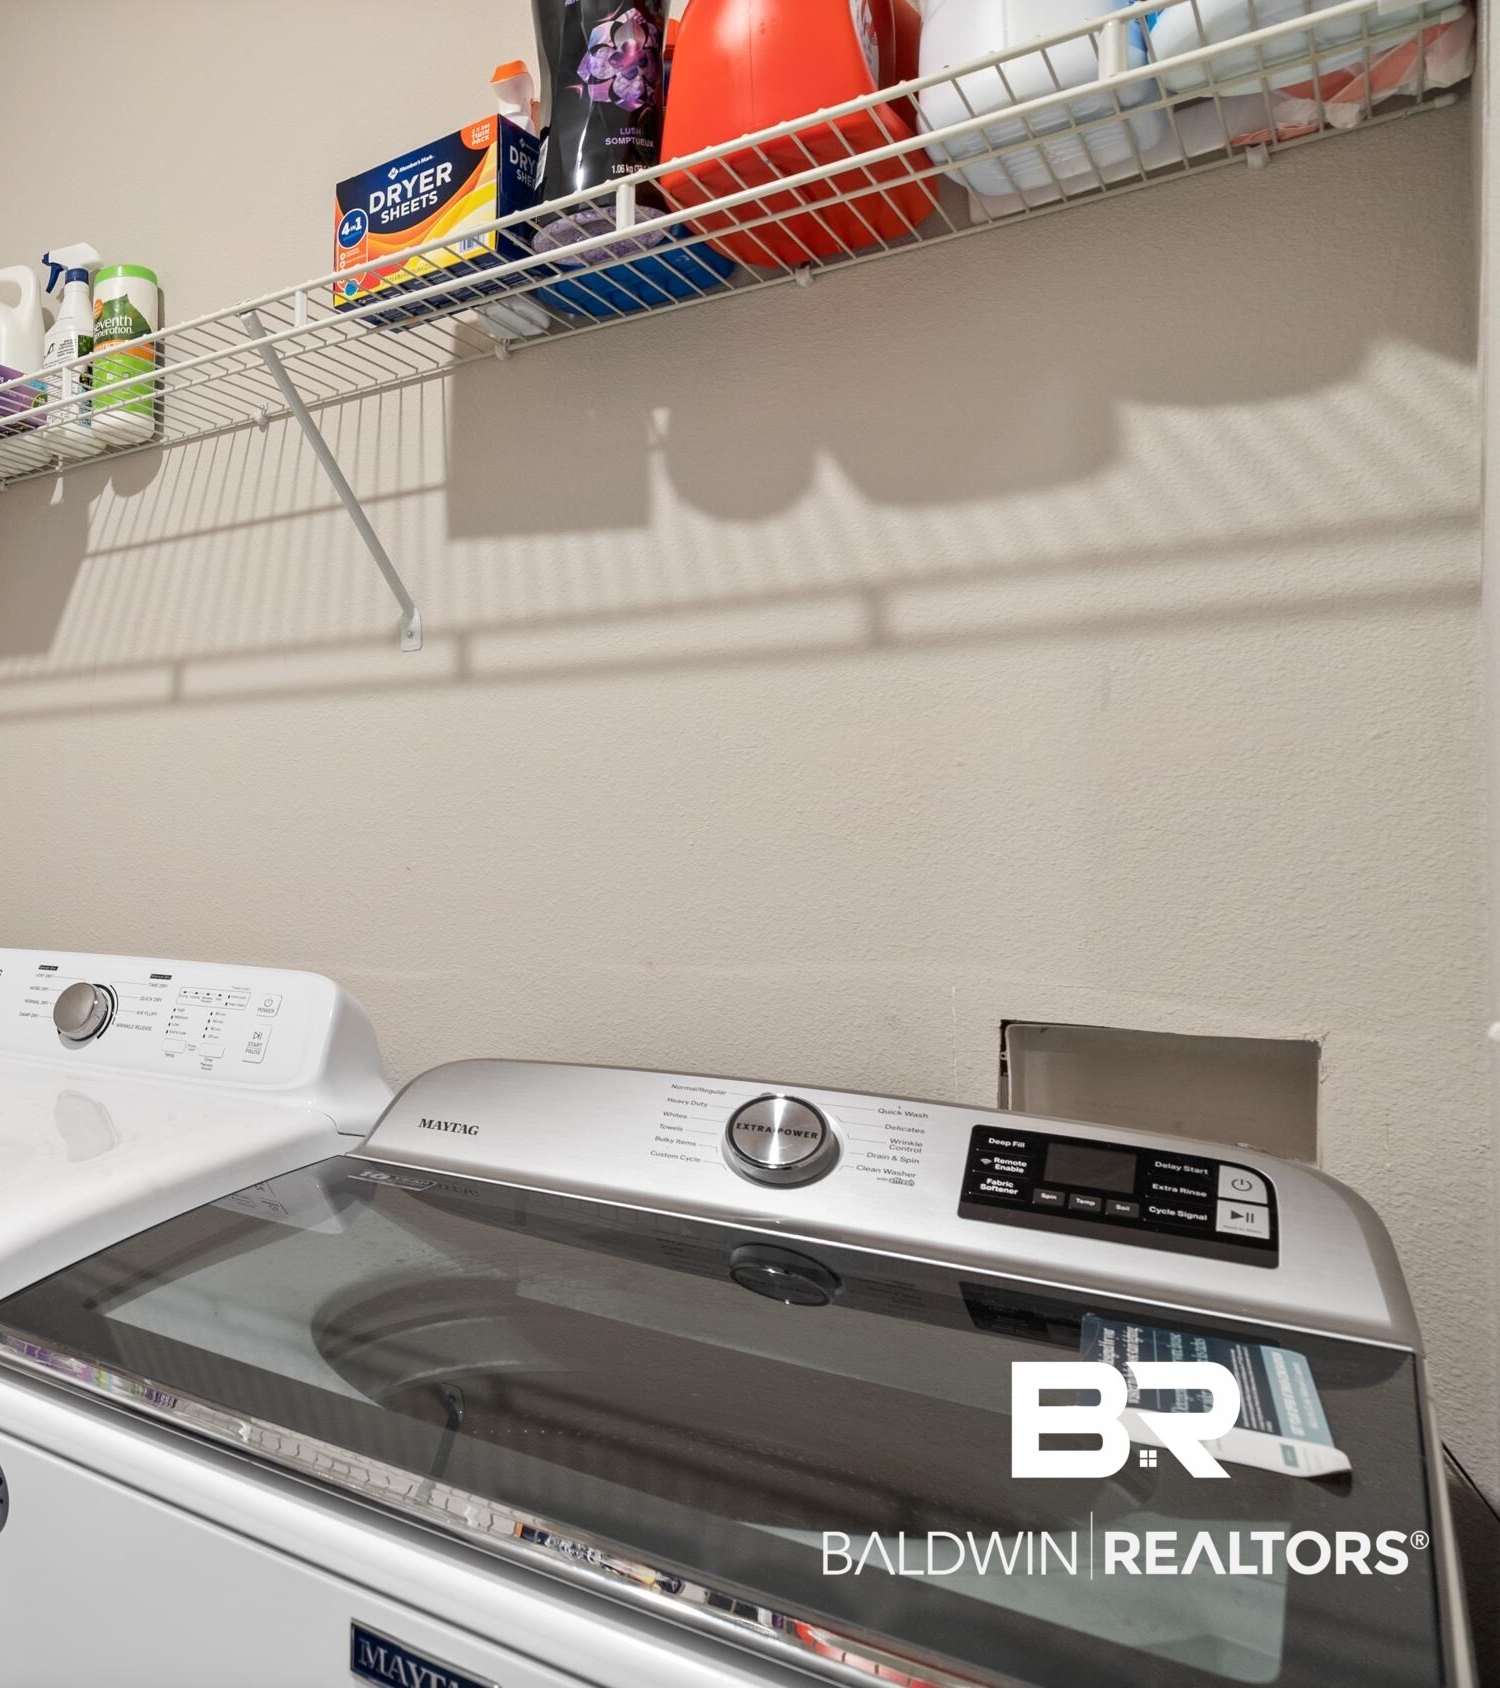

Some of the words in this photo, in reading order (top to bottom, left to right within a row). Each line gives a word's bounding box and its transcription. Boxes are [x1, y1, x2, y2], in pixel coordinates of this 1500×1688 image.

[620, 128, 642, 136] LUSH
[472, 135, 490, 146] PACK
[605, 136, 654, 148] SOMPTUEUX
[510, 145, 536, 175] DRY
[370, 162, 452, 214] DRYER
[381, 190, 438, 224] SHEETS
[671, 1083, 727, 1095] Normal/Regular
[418, 1118, 479, 1135] MAYTAG
[660, 1123, 683, 1131] Towels
[736, 1123, 772, 1133] EXTRA
[777, 1128, 818, 1139] POWER
[884, 1124, 925, 1134] Delicates
[654, 1136, 675, 1144] Bulky
[890, 1138, 923, 1147] Wrinkle
[988, 1138, 1011, 1147] Deep
[889, 1144, 922, 1153] Control
[650, 1150, 678, 1159] Custom
[866, 1152, 890, 1160] Drain
[900, 1156, 920, 1164] Spin
[994, 1157, 1027, 1168] Remote
[1154, 1161, 1182, 1172] Delay
[1183, 1166, 1208, 1175] Start
[856, 1165, 881, 1173] Clean
[884, 1169, 916, 1178] Washer
[994, 1164, 1024, 1174] Enable
[986, 1178, 1014, 1188] Fabric
[980, 1184, 1018, 1195] Softener
[1152, 1184, 1178, 1193] Extra
[1180, 1188, 1207, 1197] Rinse
[1076, 1198, 1095, 1206] Temp
[1149, 1206, 1176, 1217] Cycle
[1177, 1211, 1208, 1221] Signal
[358, 1638, 460, 1688] MAYT
